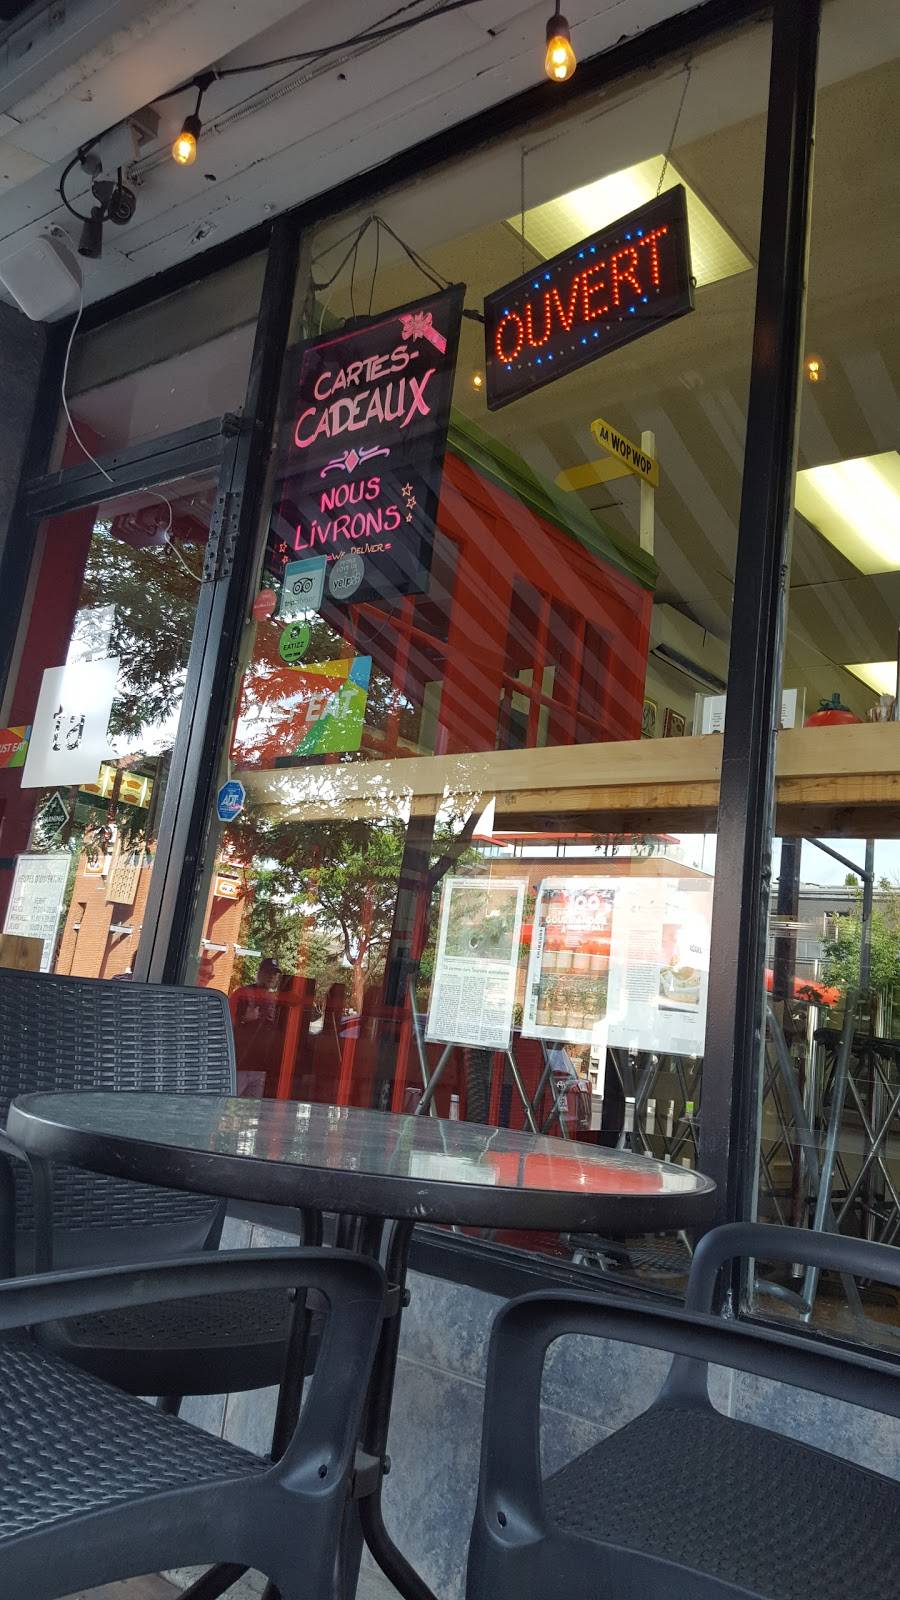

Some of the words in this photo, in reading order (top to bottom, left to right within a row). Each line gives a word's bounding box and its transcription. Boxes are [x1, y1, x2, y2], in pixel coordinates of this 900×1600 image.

[497, 226, 668, 363] OUVERT
[294, 368, 436, 448] CADEAUX
[319, 476, 381, 513] NOUS
[332, 576, 352, 593] yelp
[305, 689, 360, 722] EAT
[0, 743, 12, 753] UST
[12, 741, 26, 753] EAT
